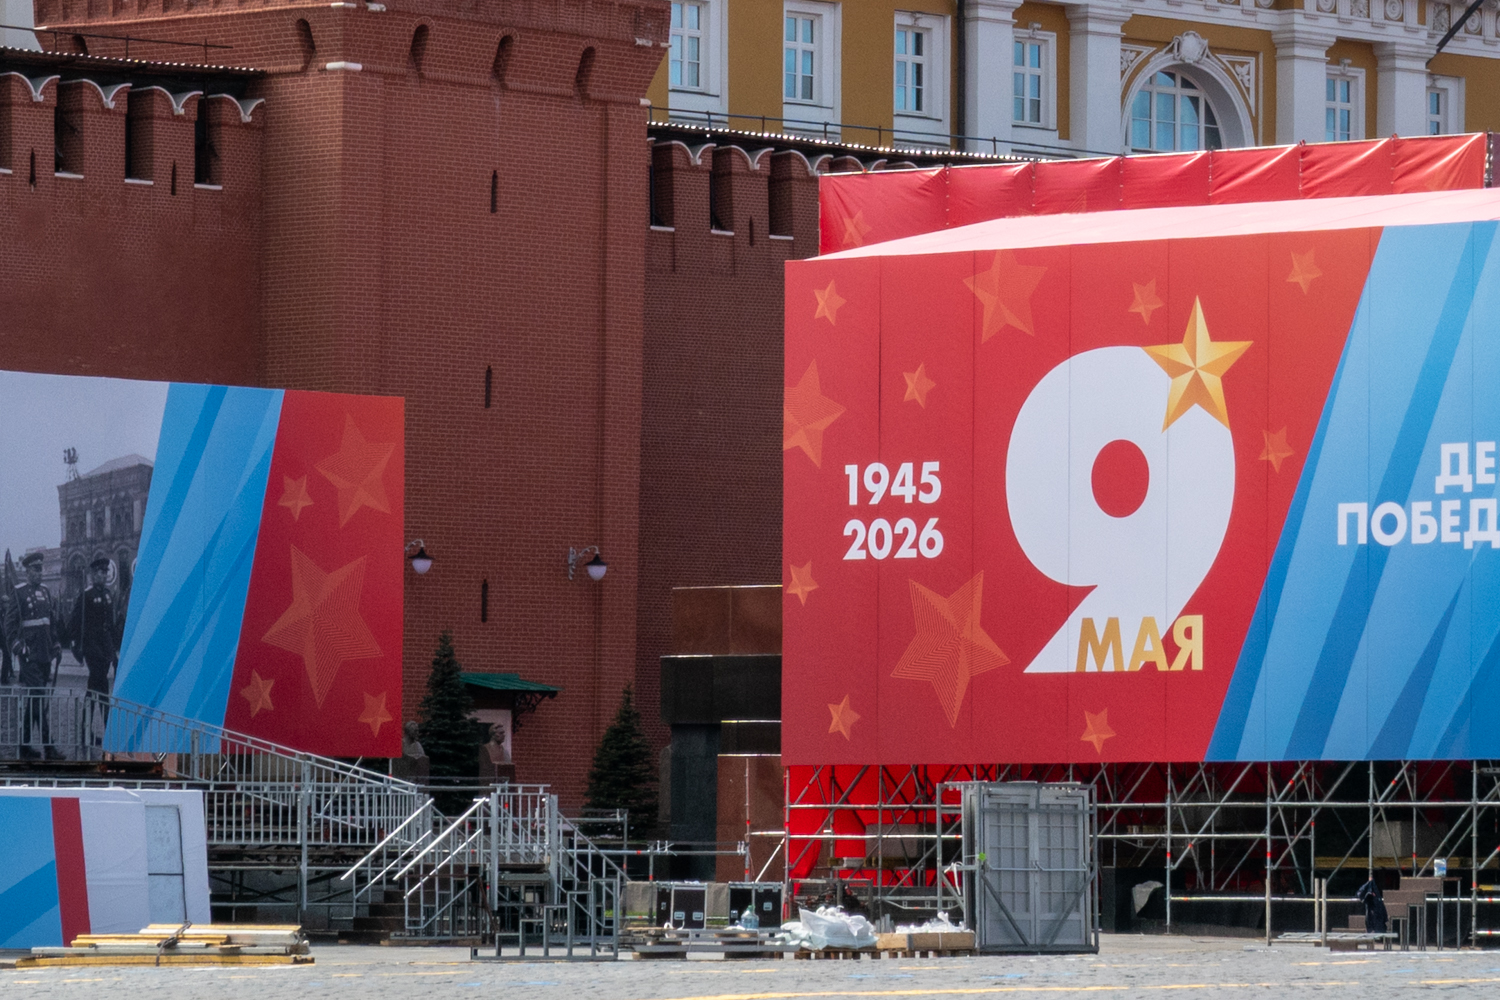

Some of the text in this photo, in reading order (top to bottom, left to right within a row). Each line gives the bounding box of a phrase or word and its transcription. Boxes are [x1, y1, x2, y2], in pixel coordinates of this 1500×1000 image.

[844, 461, 942, 506] 1945
[1005, 345, 1236, 673] 9 МАЯ
[843, 517, 944, 561] 2026
